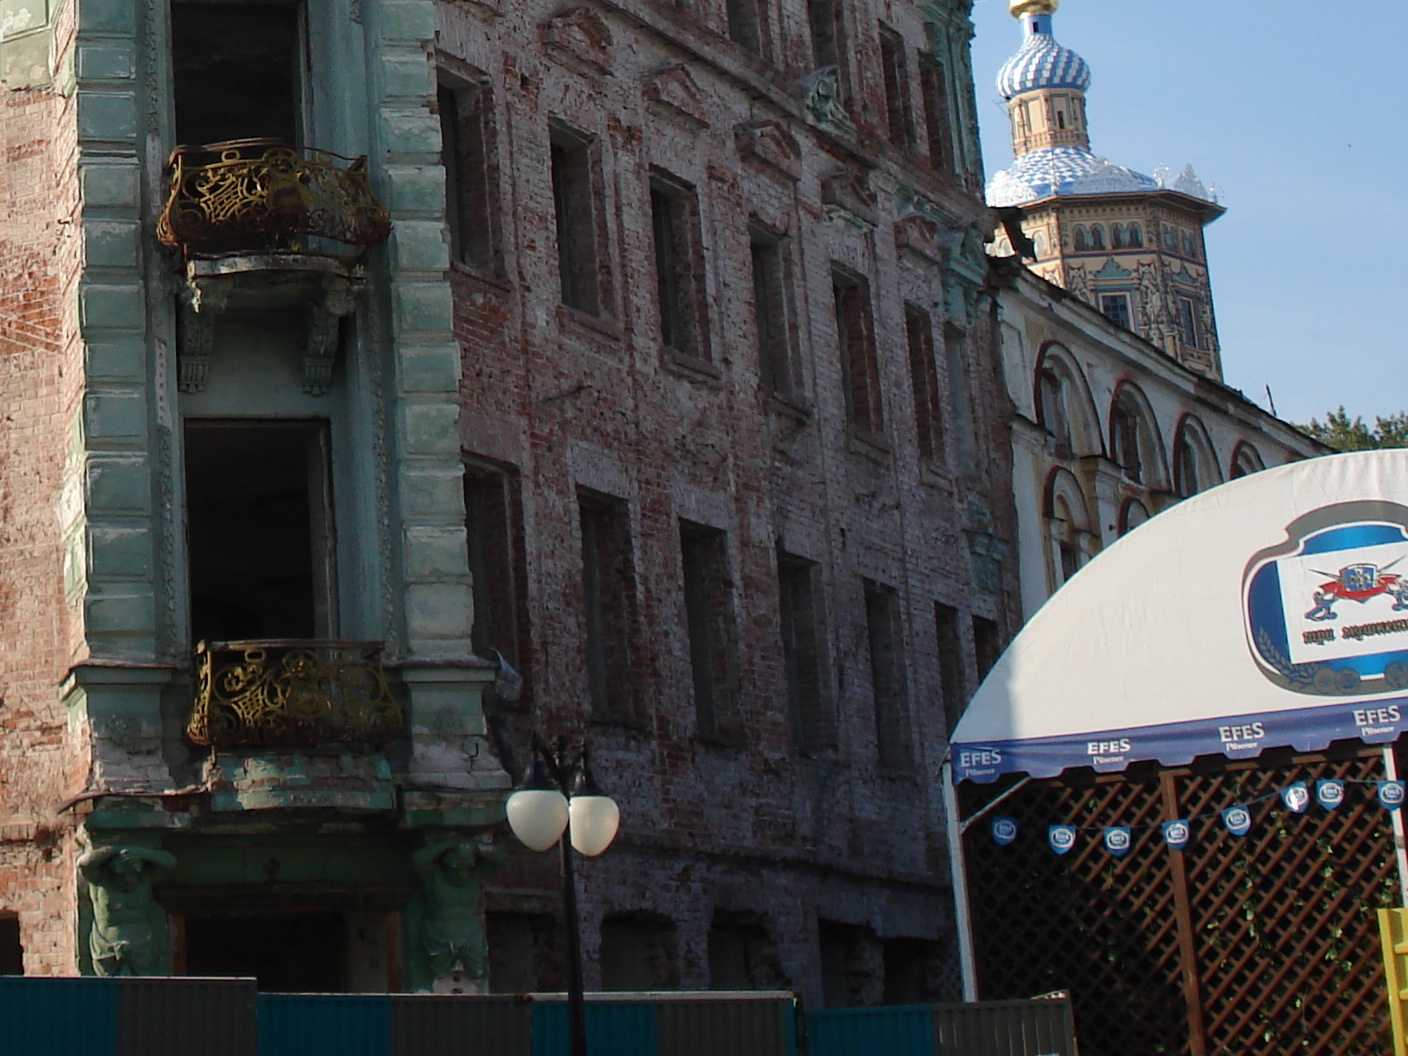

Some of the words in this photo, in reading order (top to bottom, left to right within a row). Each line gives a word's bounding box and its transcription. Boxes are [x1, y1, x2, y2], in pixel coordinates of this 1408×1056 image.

[1353, 705, 1401, 726] EFES
[1219, 722, 1265, 742] EFES
[1361, 725, 1395, 736] Pilsener
[1087, 738, 1131, 755] EFES
[1225, 741, 1259, 751] Pilsener
[960, 749, 1002, 767] EFES
[1093, 755, 1124, 765] Pilsener
